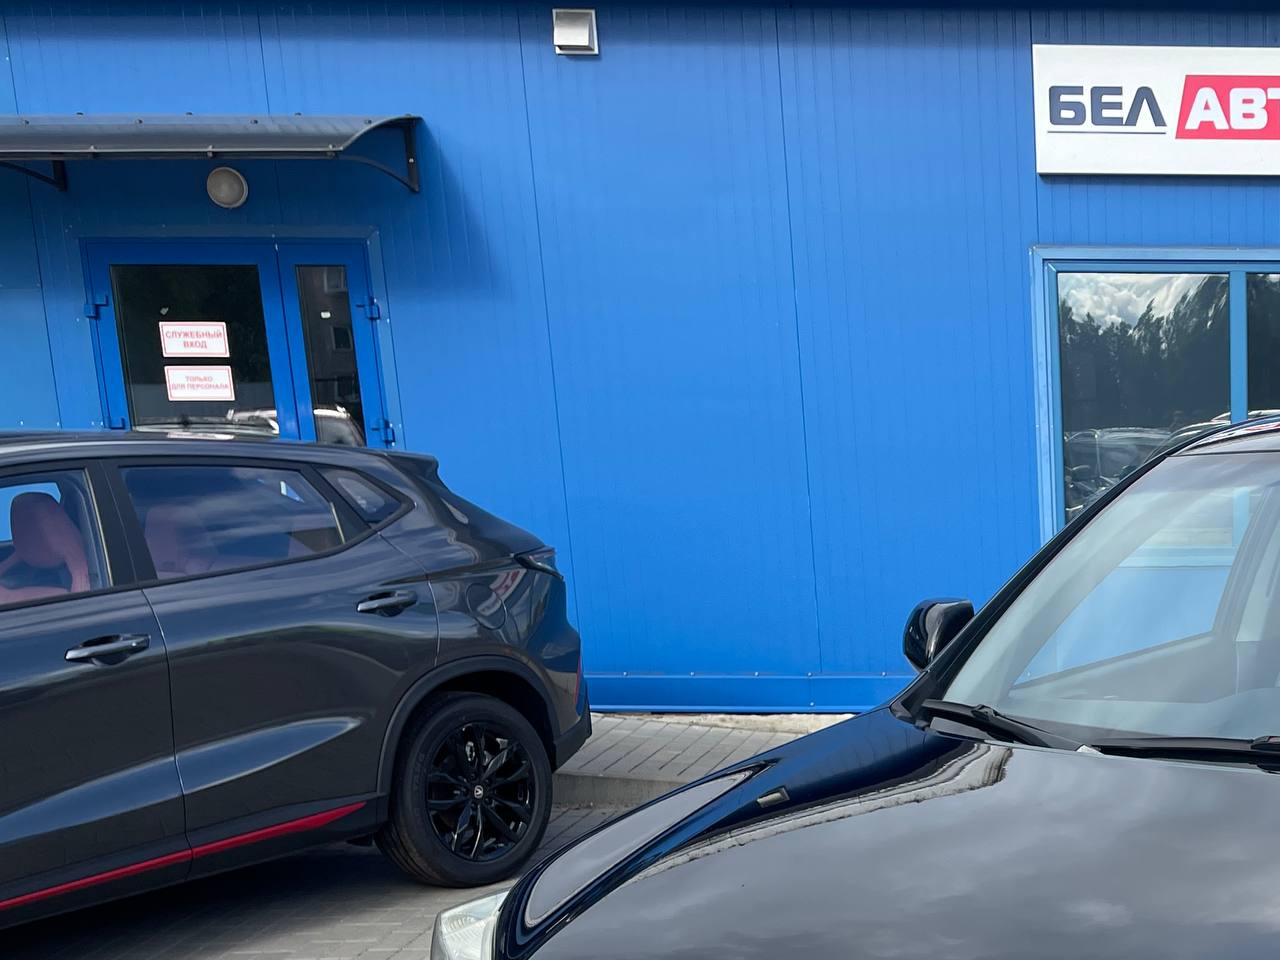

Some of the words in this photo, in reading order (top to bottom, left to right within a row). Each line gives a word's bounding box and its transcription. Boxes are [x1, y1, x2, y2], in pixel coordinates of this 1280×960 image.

[1048, 85, 1167, 127] БЕЛ
[165, 330, 223, 339] СЛУЖЕБНЫЙ
[183, 340, 208, 349] ВХОД
[171, 383, 186, 391] ДЛЯ
